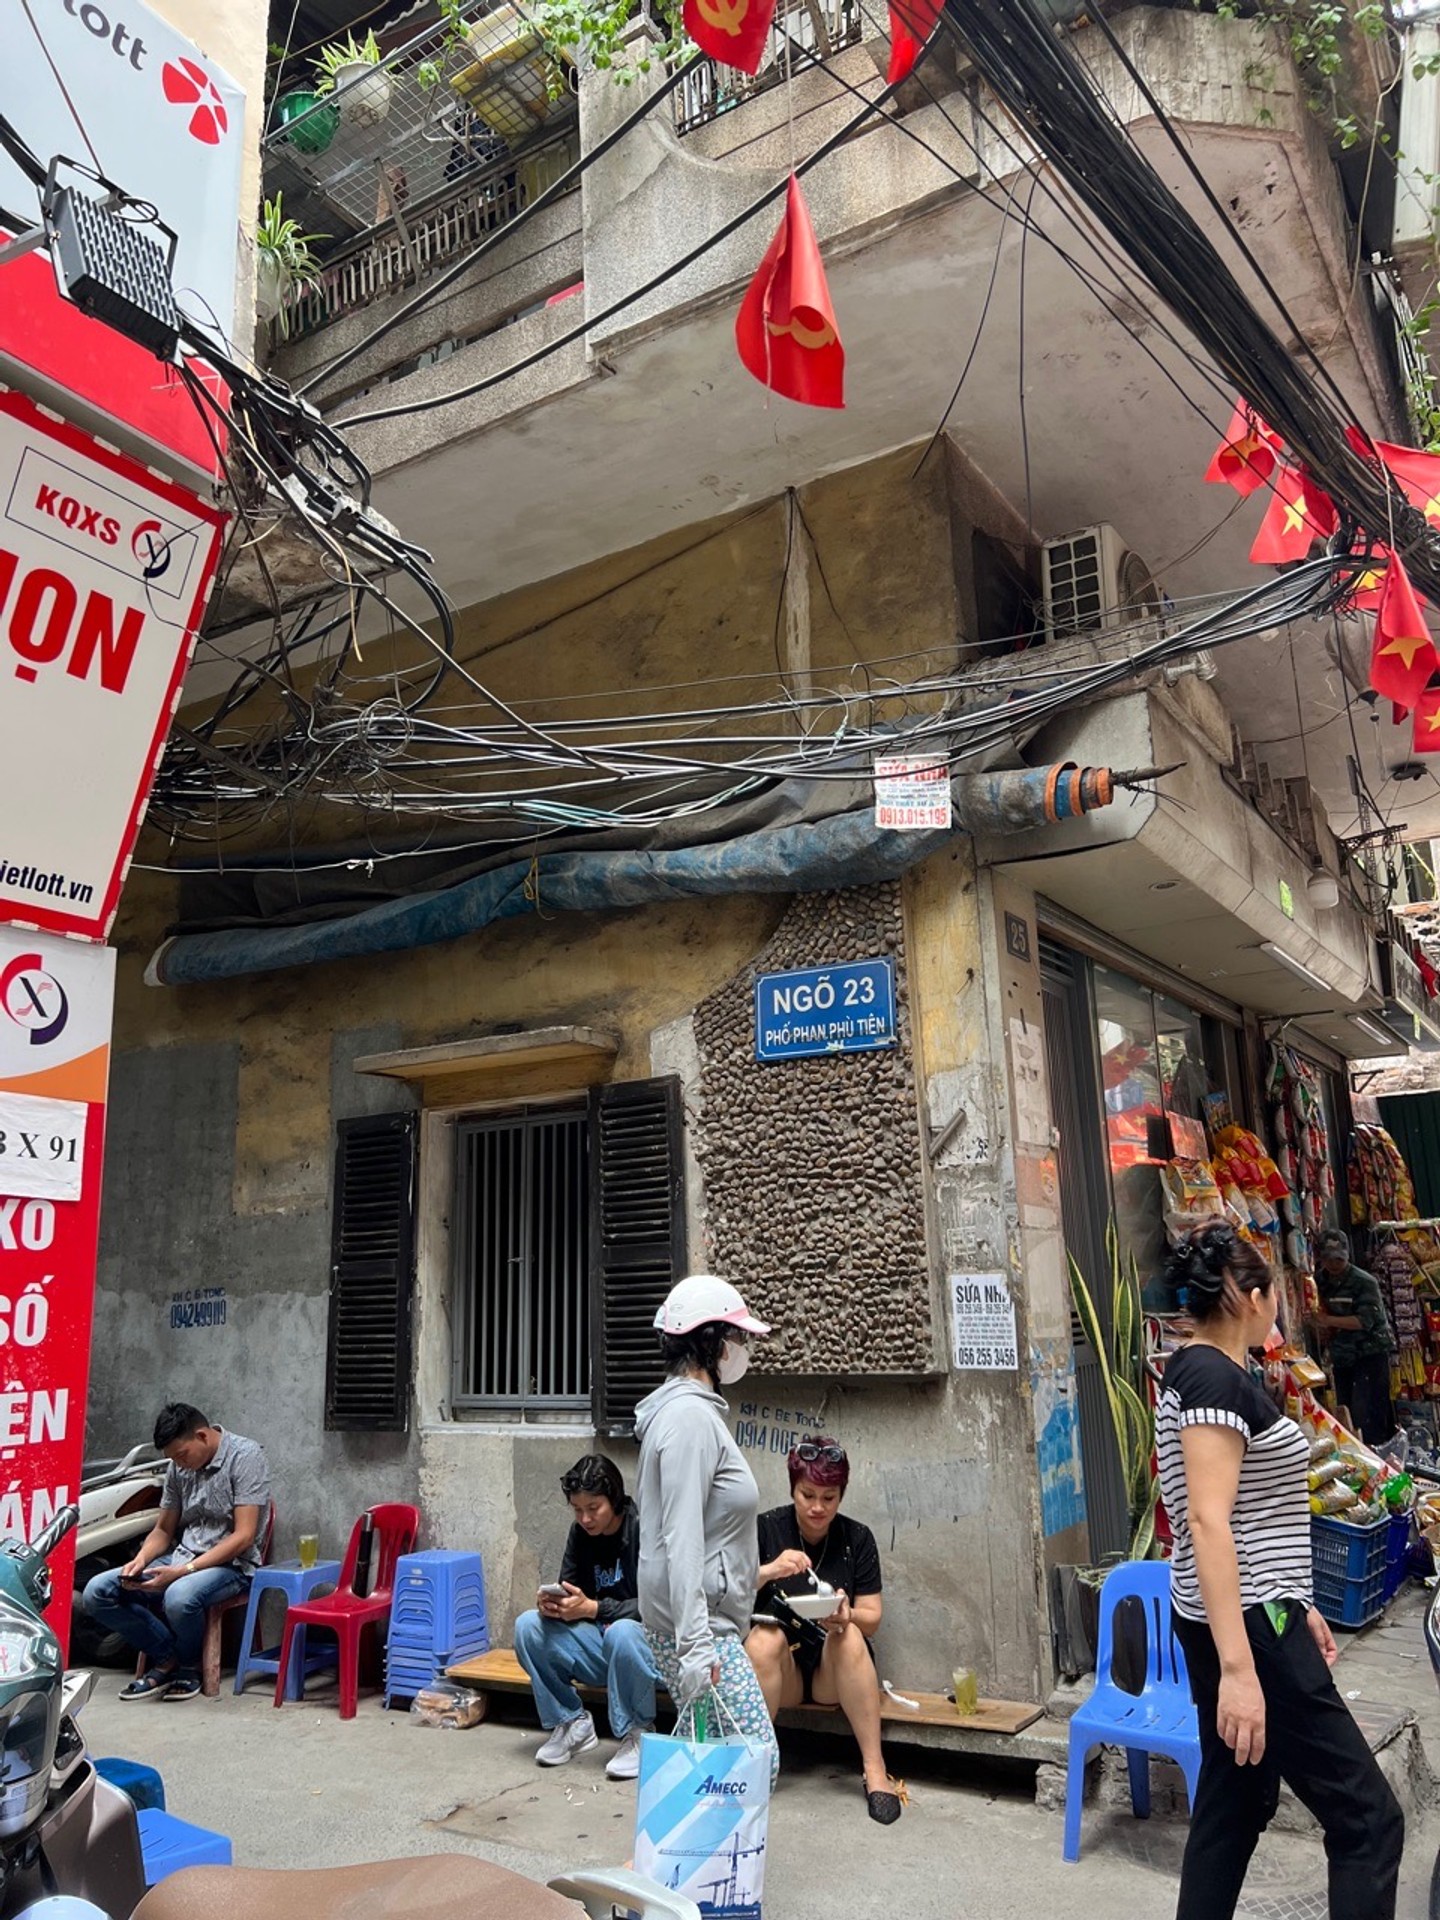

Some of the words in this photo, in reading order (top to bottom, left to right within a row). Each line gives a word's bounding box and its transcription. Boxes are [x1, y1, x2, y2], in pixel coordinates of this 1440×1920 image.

[35, 483, 121, 546] KQXS
[1011, 922, 1026, 952] 25
[773, 975, 836, 1015] NGÕ
[843, 976, 876, 1006] 23
[765, 1020, 791, 1047] PHỐ
[793, 1023, 826, 1043] PHAN
[829, 1015, 855, 1039] PHÙ
[857, 1012, 886, 1035] TIÊN
[17, 1132, 41, 1159] X
[50, 1135, 77, 1162] 91
[956, 1276, 981, 1303] SỬA
[958, 1347, 975, 1366] 056
[977, 1347, 993, 1366] 255
[994, 1347, 1016, 1367] 3456
[740, 1402, 757, 1417] KH
[761, 1406, 770, 1419] C
[775, 1408, 791, 1422] BE
[736, 1420, 767, 1451] 0914
